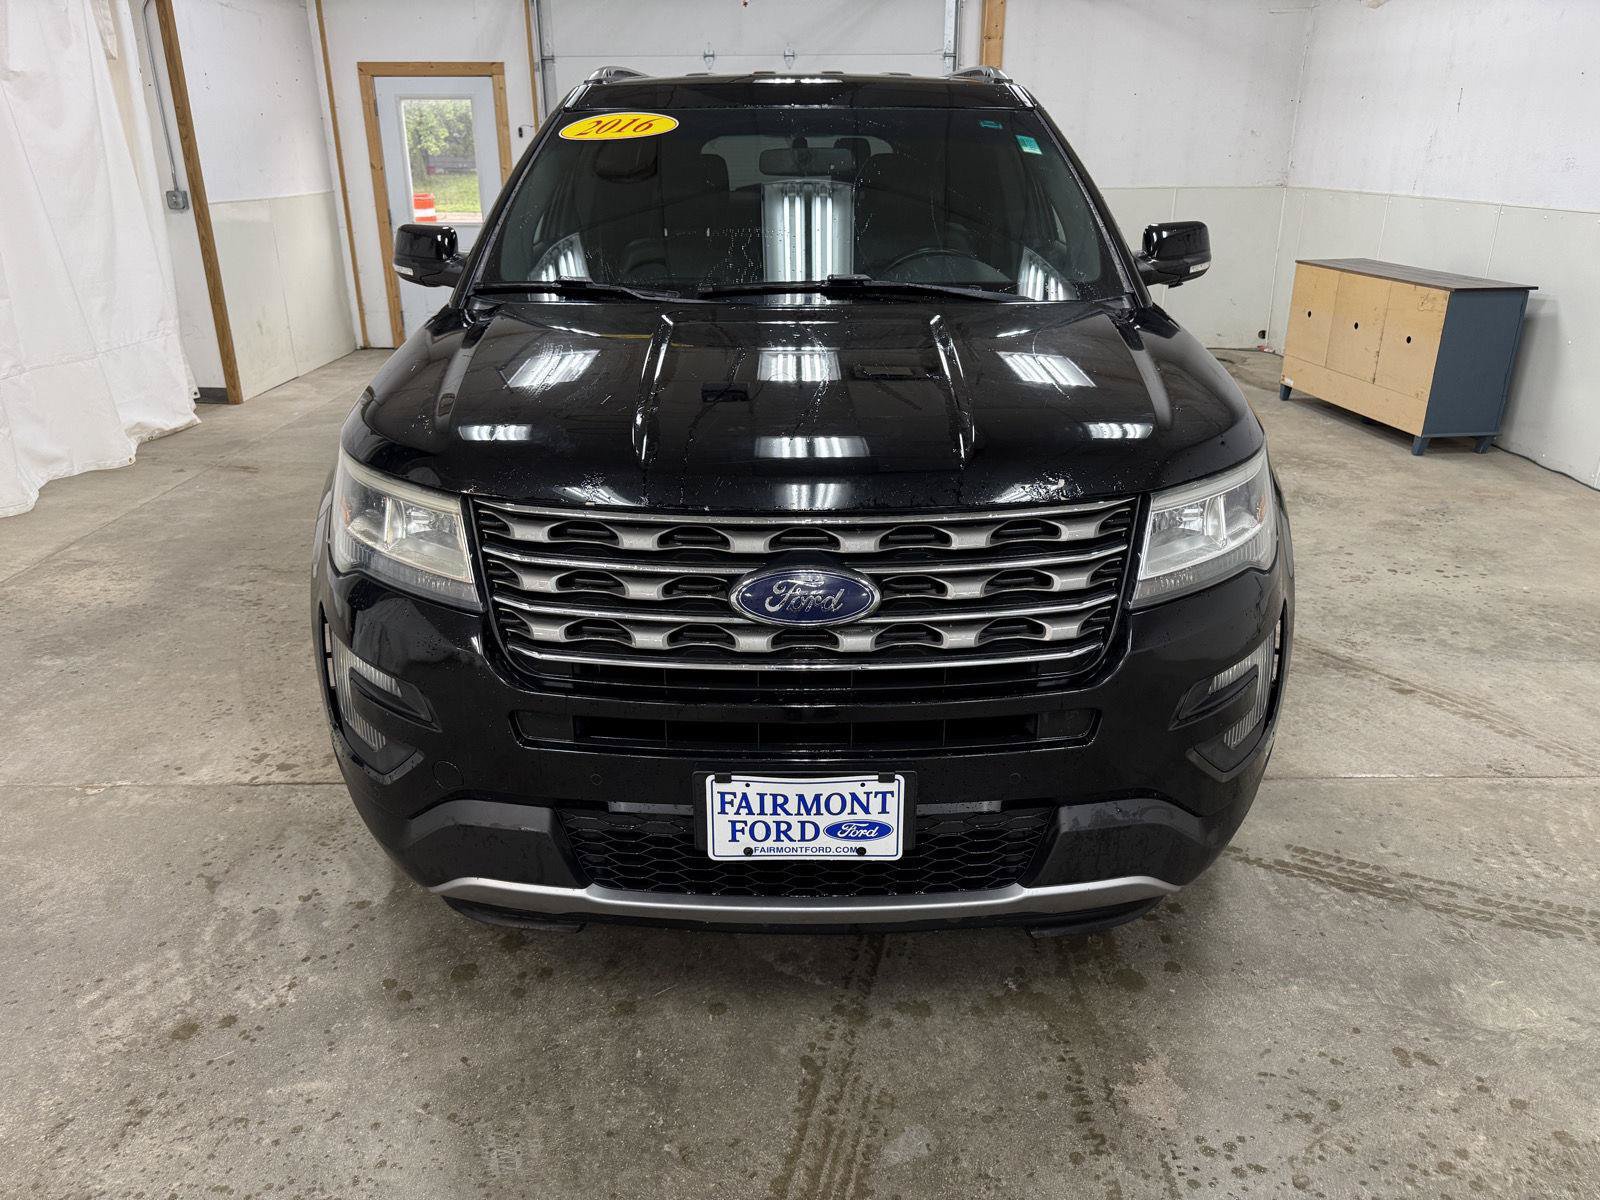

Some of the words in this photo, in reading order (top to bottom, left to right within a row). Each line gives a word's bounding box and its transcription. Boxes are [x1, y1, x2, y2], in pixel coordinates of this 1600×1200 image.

[575, 118, 661, 136] 2016
[765, 580, 845, 612] Ford
[717, 791, 894, 816] FAIRMONT
[728, 820, 820, 842] FORD
[837, 823, 879, 839] Ford
